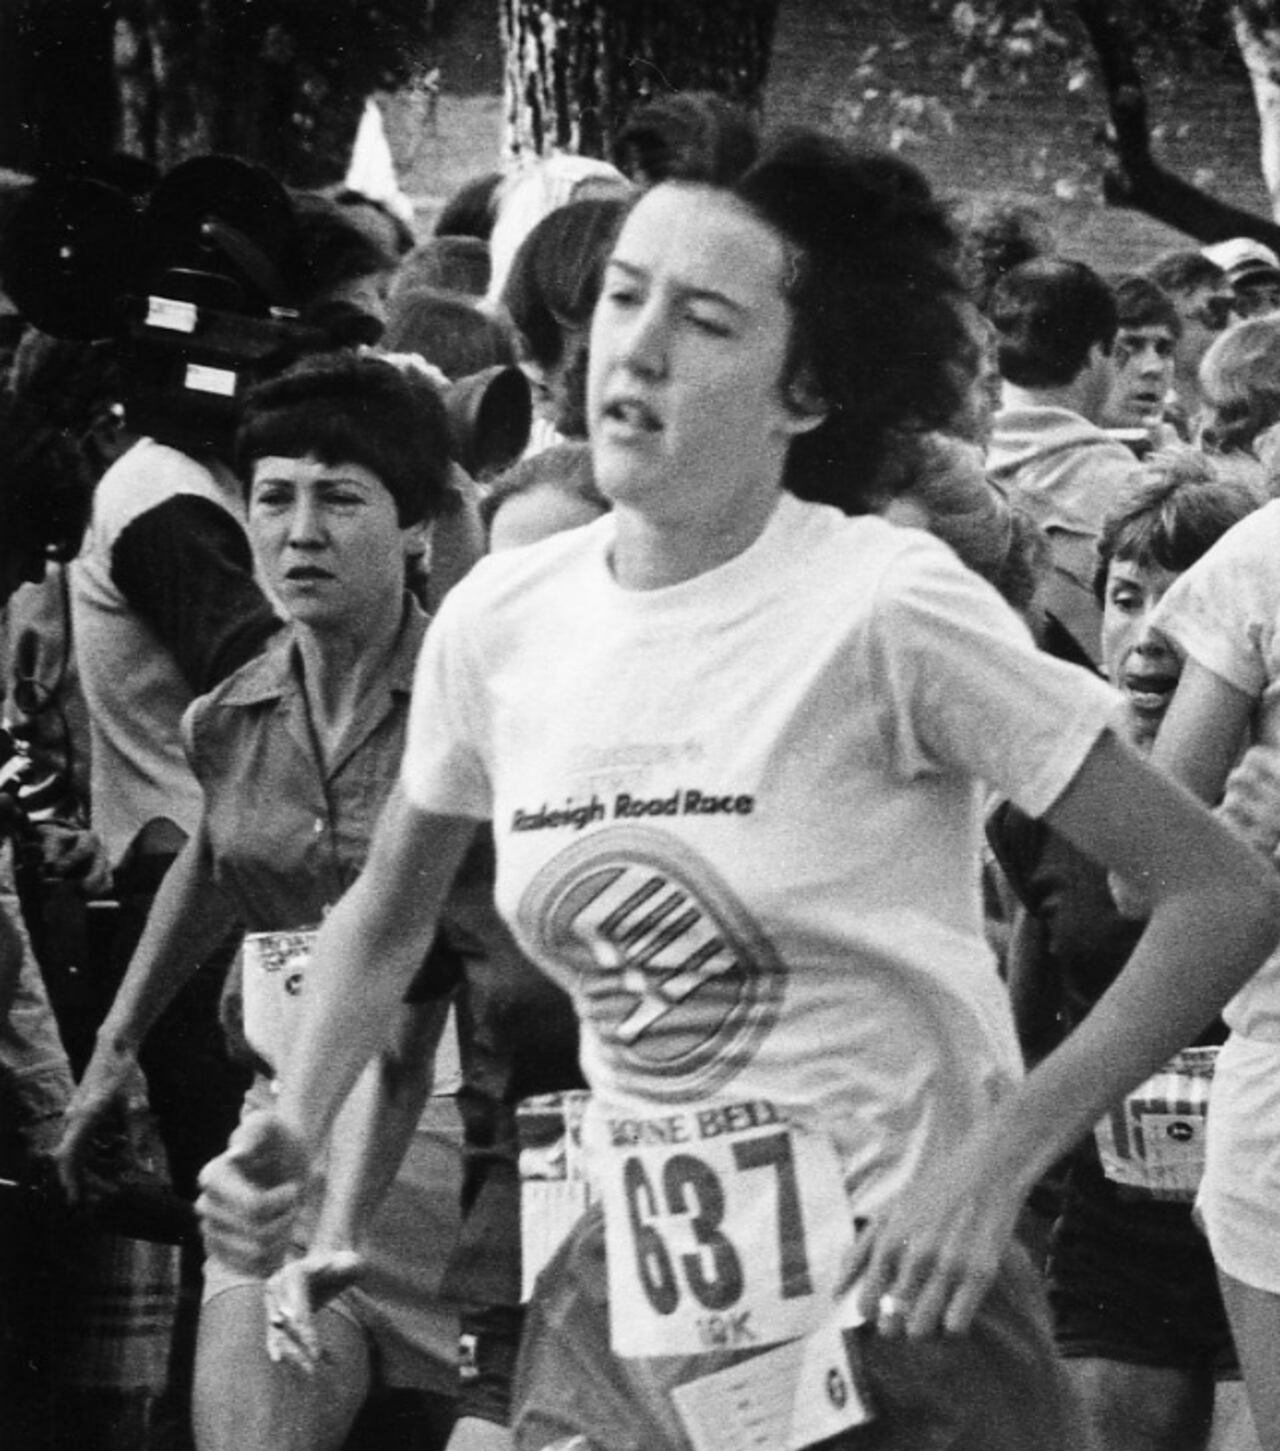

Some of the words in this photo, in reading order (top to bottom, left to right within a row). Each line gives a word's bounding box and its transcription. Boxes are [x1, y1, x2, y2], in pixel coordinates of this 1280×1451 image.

[510, 793, 605, 833] Raleigh
[614, 790, 680, 819] Road
[685, 789, 755, 816] Race
[623, 1131, 814, 1316] 637
